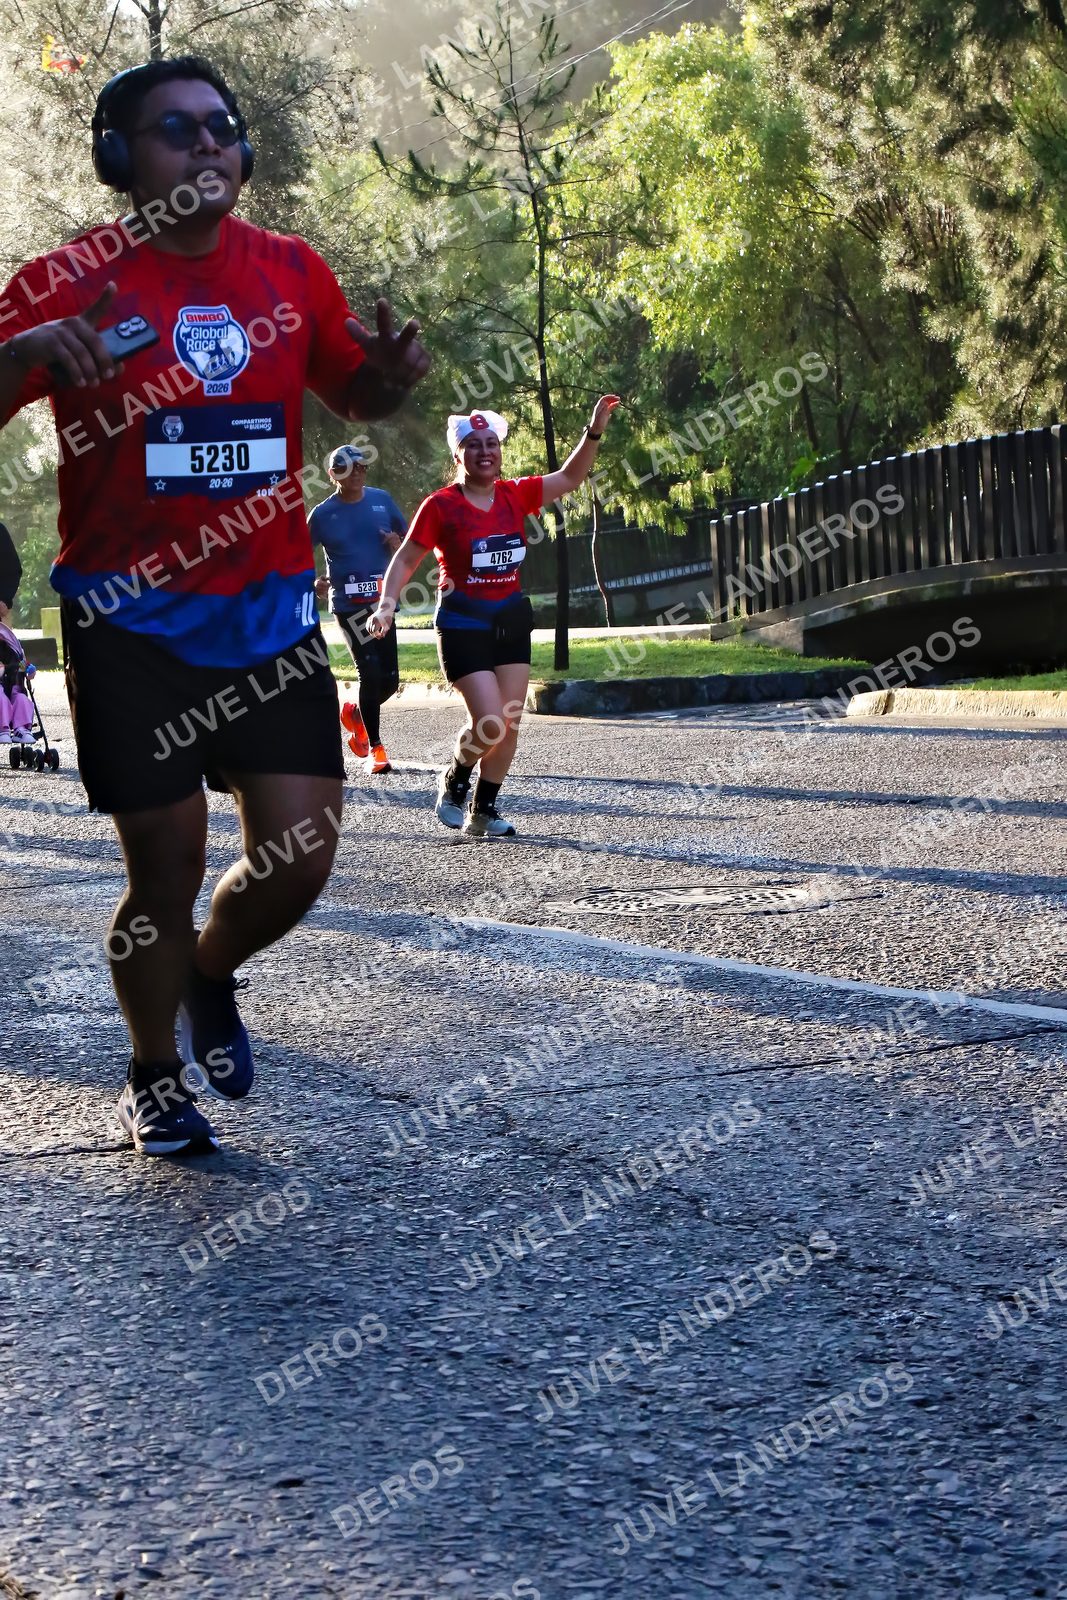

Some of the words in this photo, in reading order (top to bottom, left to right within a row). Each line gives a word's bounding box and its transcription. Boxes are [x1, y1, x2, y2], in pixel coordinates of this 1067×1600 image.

[186, 313, 225, 322] BIMBO
[191, 326, 228, 339] Global
[186, 339, 216, 351] Race
[206, 383, 229, 394] 2026
[231, 417, 272, 425] COMPARTIMOS
[190, 443, 250, 474] 5230
[490, 551, 513, 565] 4762
[357, 582, 377, 592] 5238
